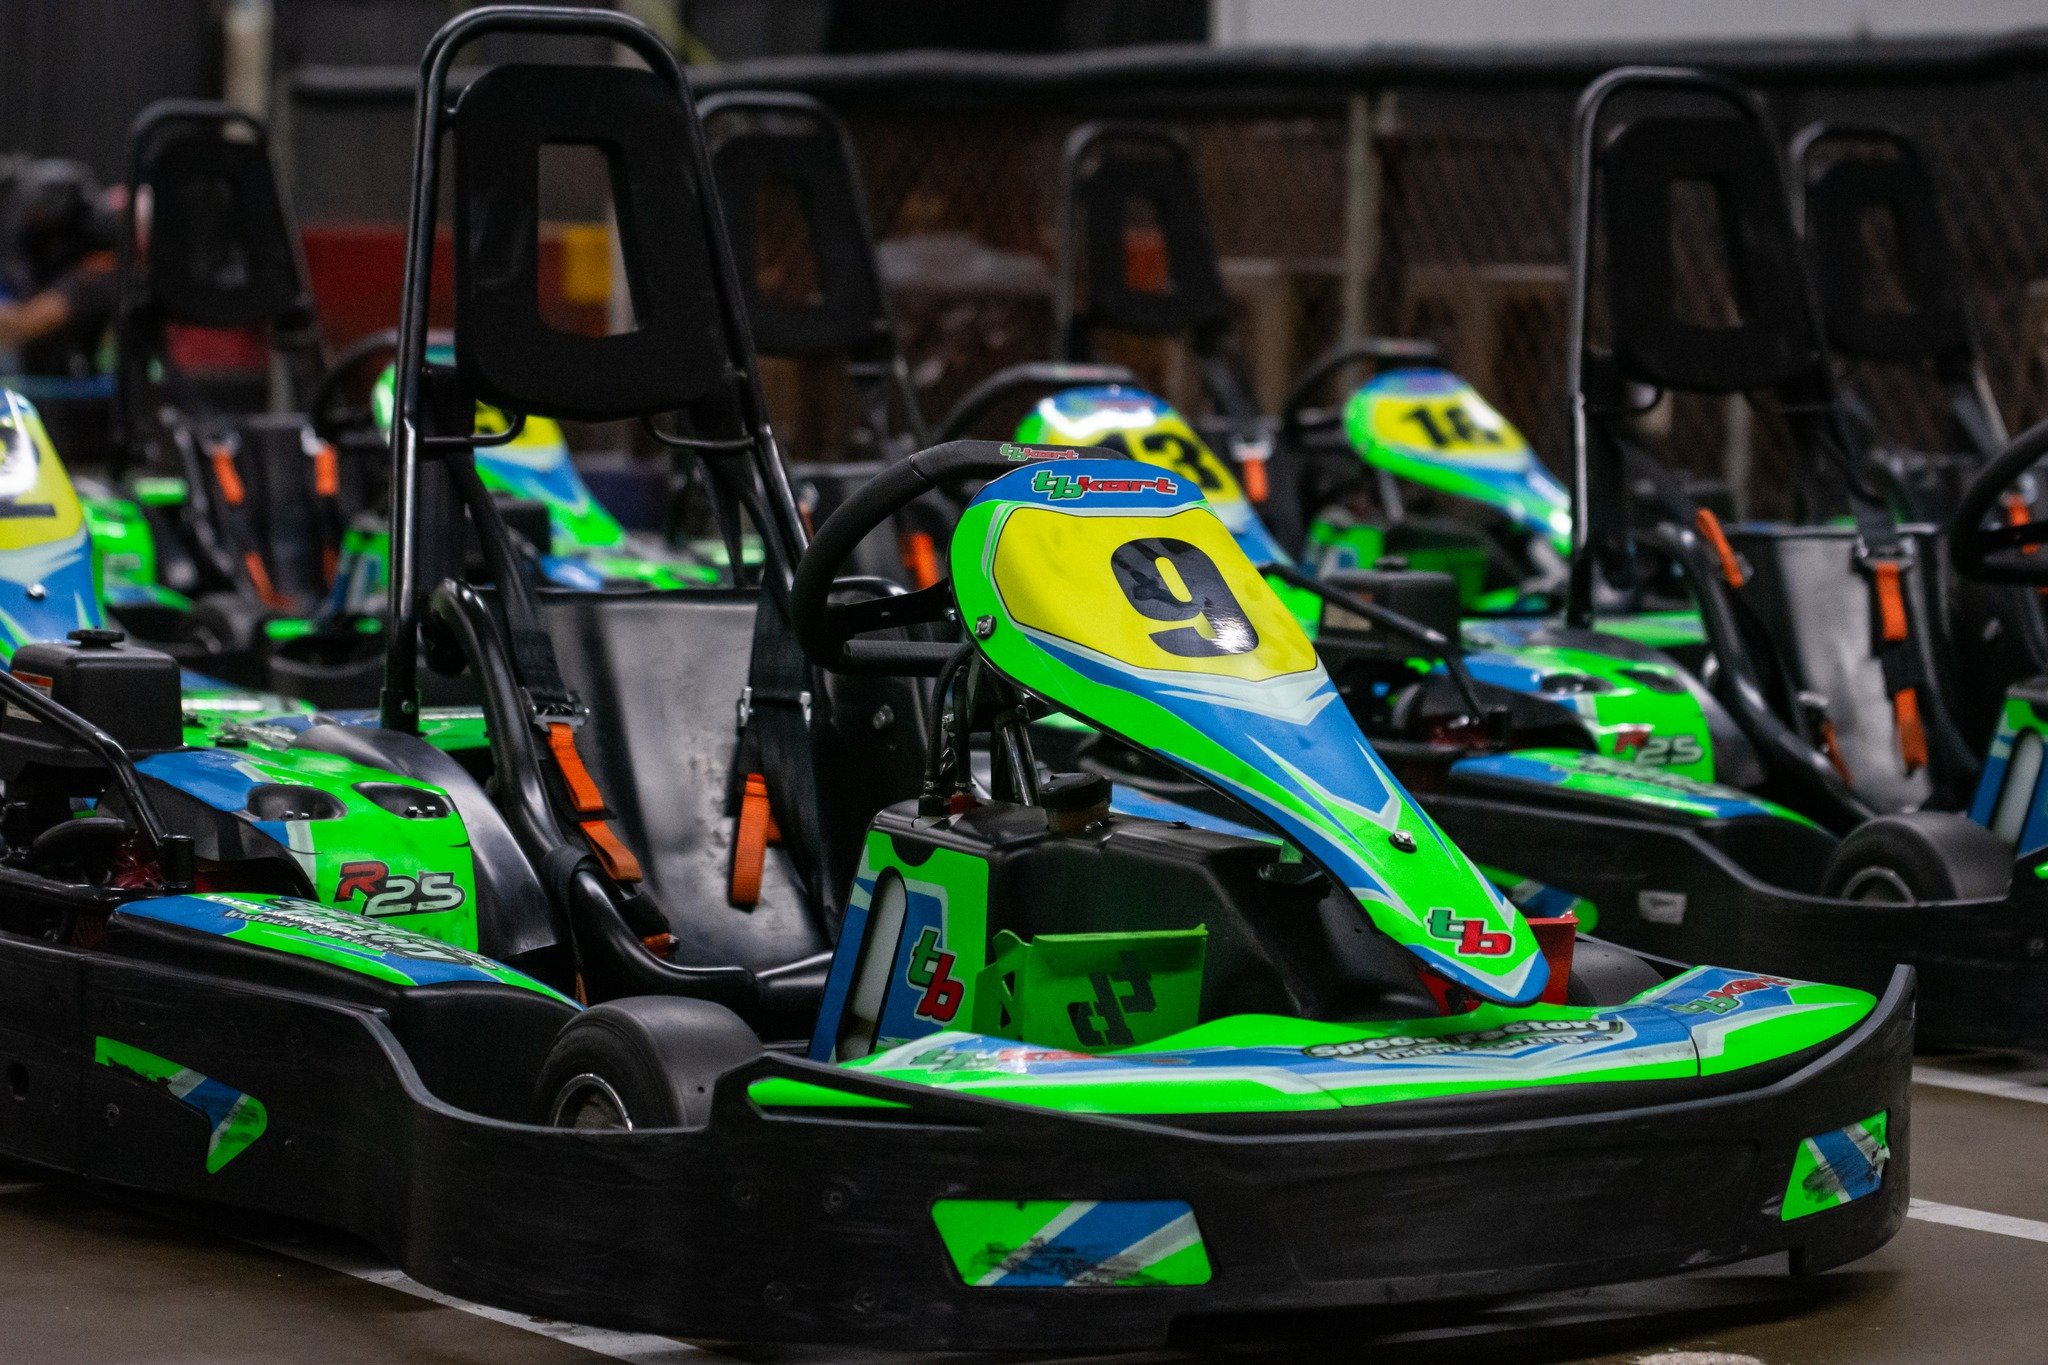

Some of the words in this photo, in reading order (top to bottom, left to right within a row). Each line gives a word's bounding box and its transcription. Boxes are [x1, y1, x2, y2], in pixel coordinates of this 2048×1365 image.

[1031, 469, 1178, 501] tbkart
[1110, 537, 1260, 658] 9
[1424, 907, 1516, 957] tb
[906, 925, 965, 1026] tb
